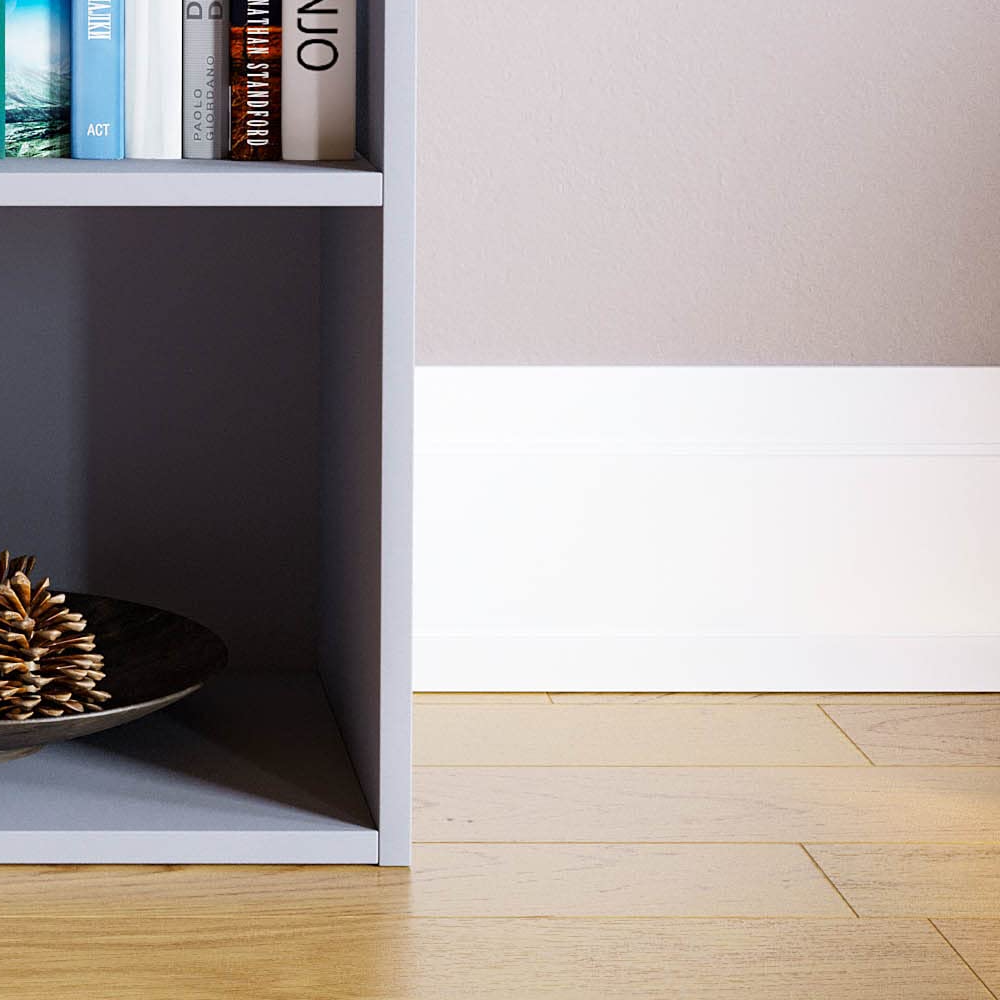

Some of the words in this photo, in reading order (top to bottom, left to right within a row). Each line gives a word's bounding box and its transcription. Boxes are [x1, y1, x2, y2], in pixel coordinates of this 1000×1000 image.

[193, 88, 203, 141] PAOLO
[206, 55, 216, 141] GIORDANO
[246, 63, 270, 147] STANDFORD
